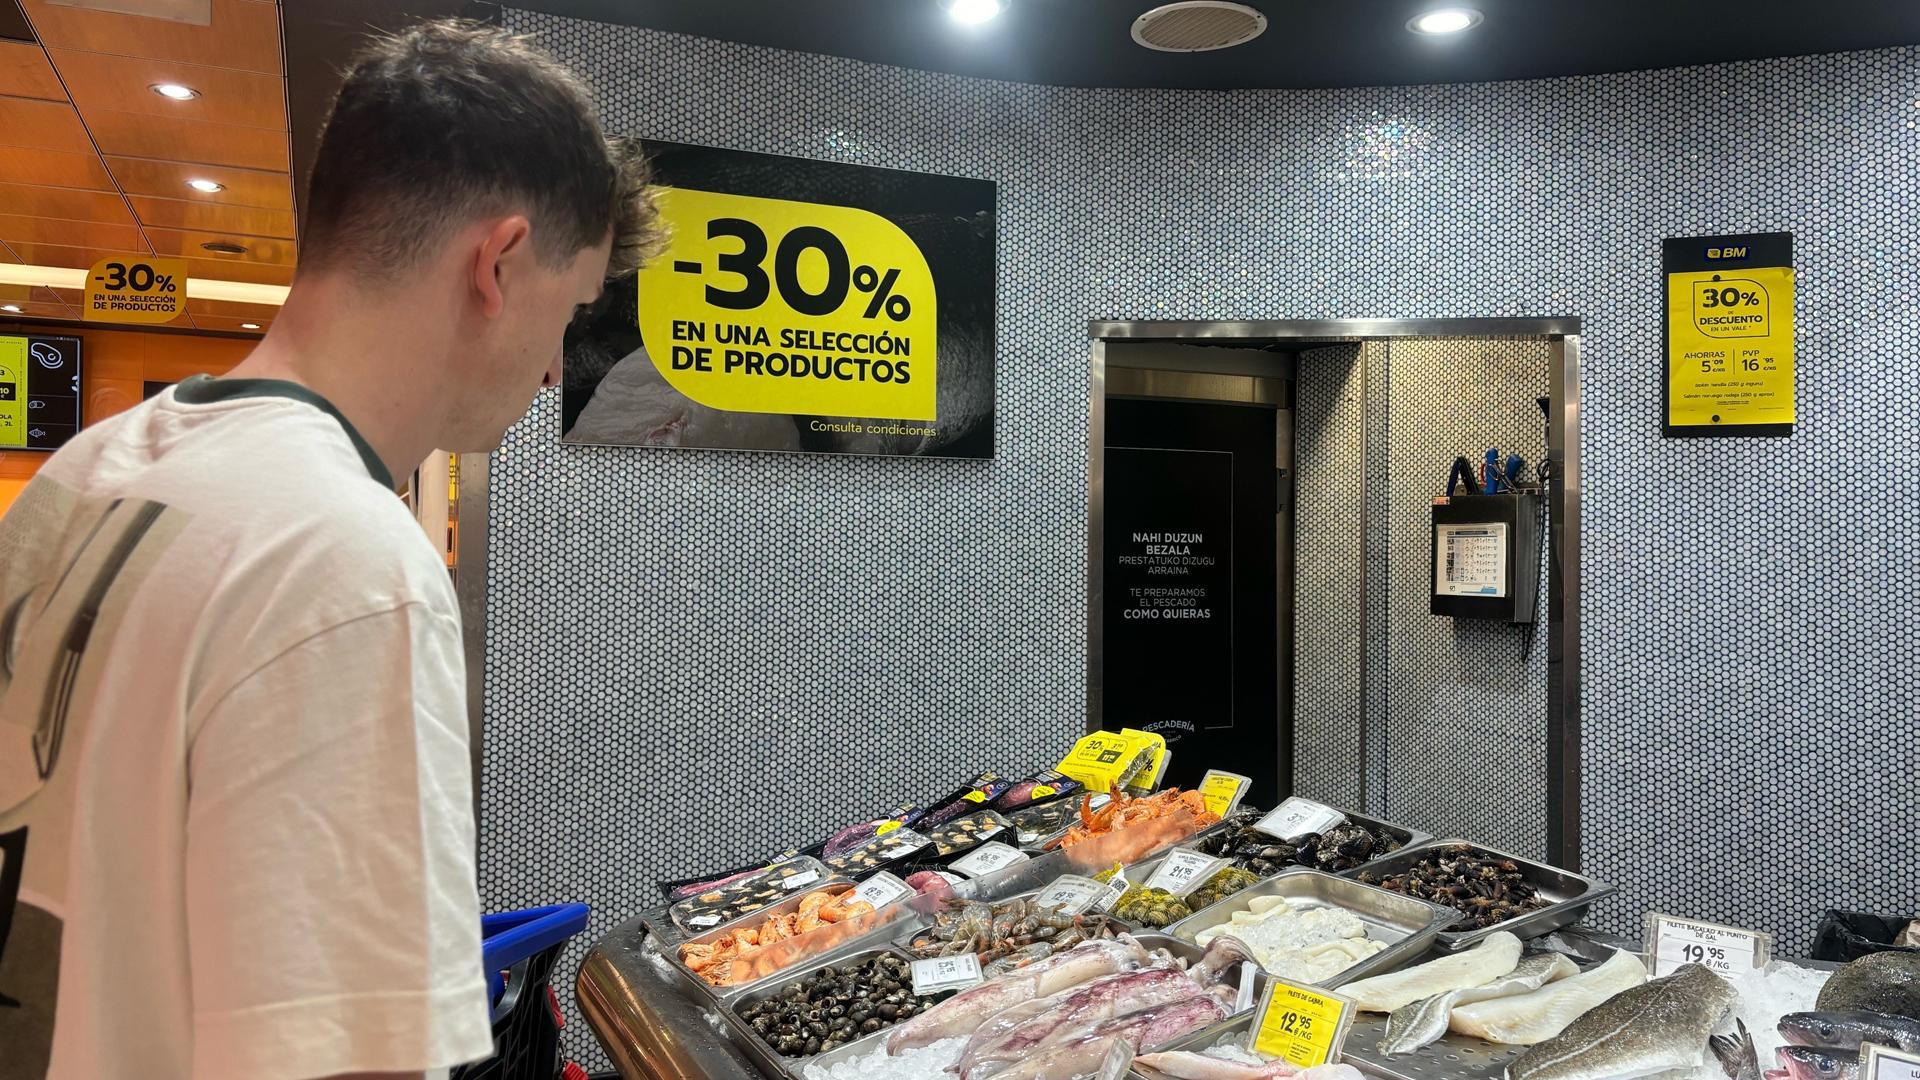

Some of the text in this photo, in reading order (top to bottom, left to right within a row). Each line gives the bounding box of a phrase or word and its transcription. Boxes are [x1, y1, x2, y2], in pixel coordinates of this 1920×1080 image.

[1723, 247, 1747, 258] BM
[674, 218, 911, 322] -30%
[95, 262, 176, 292] -30%
[108, 294, 126, 302] UNA
[129, 295, 176, 303] SELECCIÓN
[1703, 287, 1760, 308] 30%
[93, 302, 176, 312] DE PRODUCTOS
[1699, 315, 1763, 325] DESCUENTO
[672, 320, 911, 357] EN UNA SELECCIÓN
[1684, 351, 1725, 359] AHORRAS
[672, 347, 911, 384] DE PRODUCTOS
[1701, 360, 1711, 373] 5
[1741, 359, 1759, 371] 16
[810, 420, 937, 437] Consulta condiciones
[1133, 532, 1203, 543] NAHI DUZUN
[1146, 545, 1191, 555] BEZALA
[1119, 556, 1215, 566] PRESTATUKO DIZUGU
[1148, 566, 1189, 575] ARRAINA
[1130, 588, 1206, 597] TE PREPARAMOS
[1140, 598, 1196, 607] EL PESCADO
[1123, 608, 1211, 619] COMO QUIERAS
[1142, 720, 1195, 733] PESCADERÍA
[1666, 921, 1685, 930] FILETE
[1687, 923, 1715, 934] BACALAO
[1726, 931, 1747, 939] PUNTO
[1682, 944, 1704, 962] 19
[1280, 1012, 1297, 1033] 12
